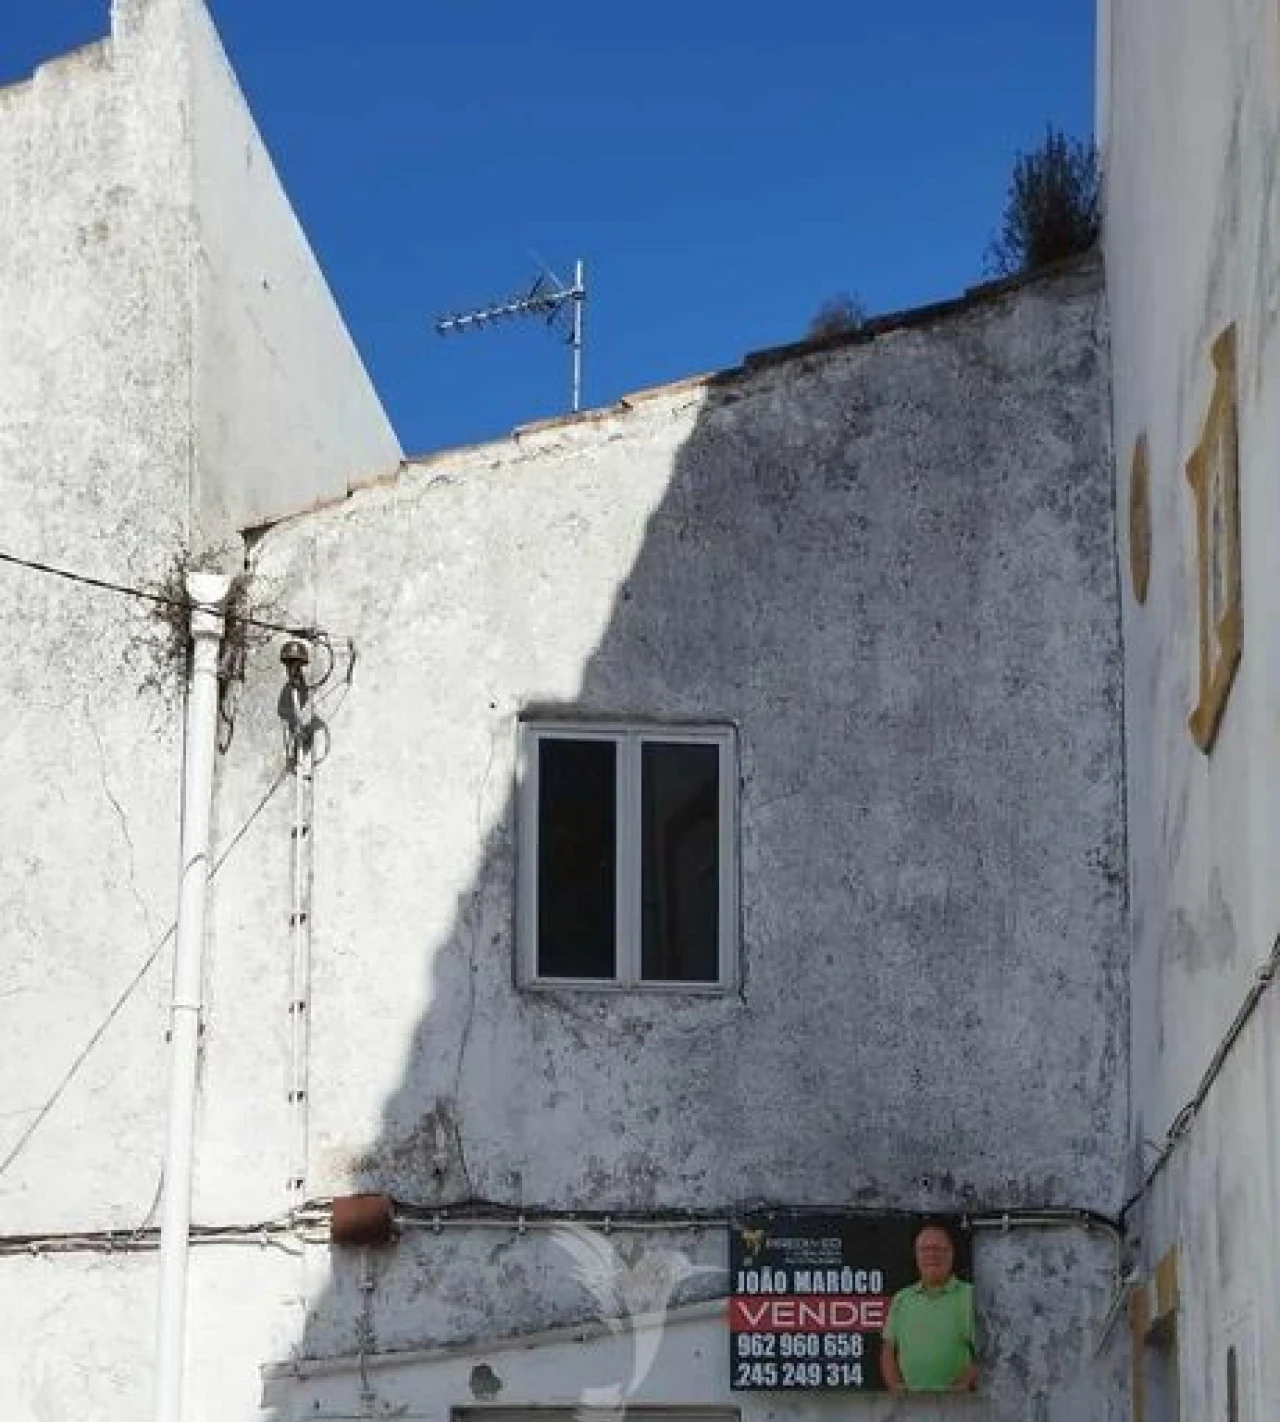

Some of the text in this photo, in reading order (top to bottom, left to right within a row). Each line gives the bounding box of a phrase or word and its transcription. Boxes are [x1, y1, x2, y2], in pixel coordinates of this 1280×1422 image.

[736, 1265, 786, 1294] JOÃO
[737, 1301, 884, 1328] VENDE
[738, 1332, 863, 1357] 962 960 658
[782, 1362, 821, 1386] 249
[826, 1362, 863, 1386] 314
